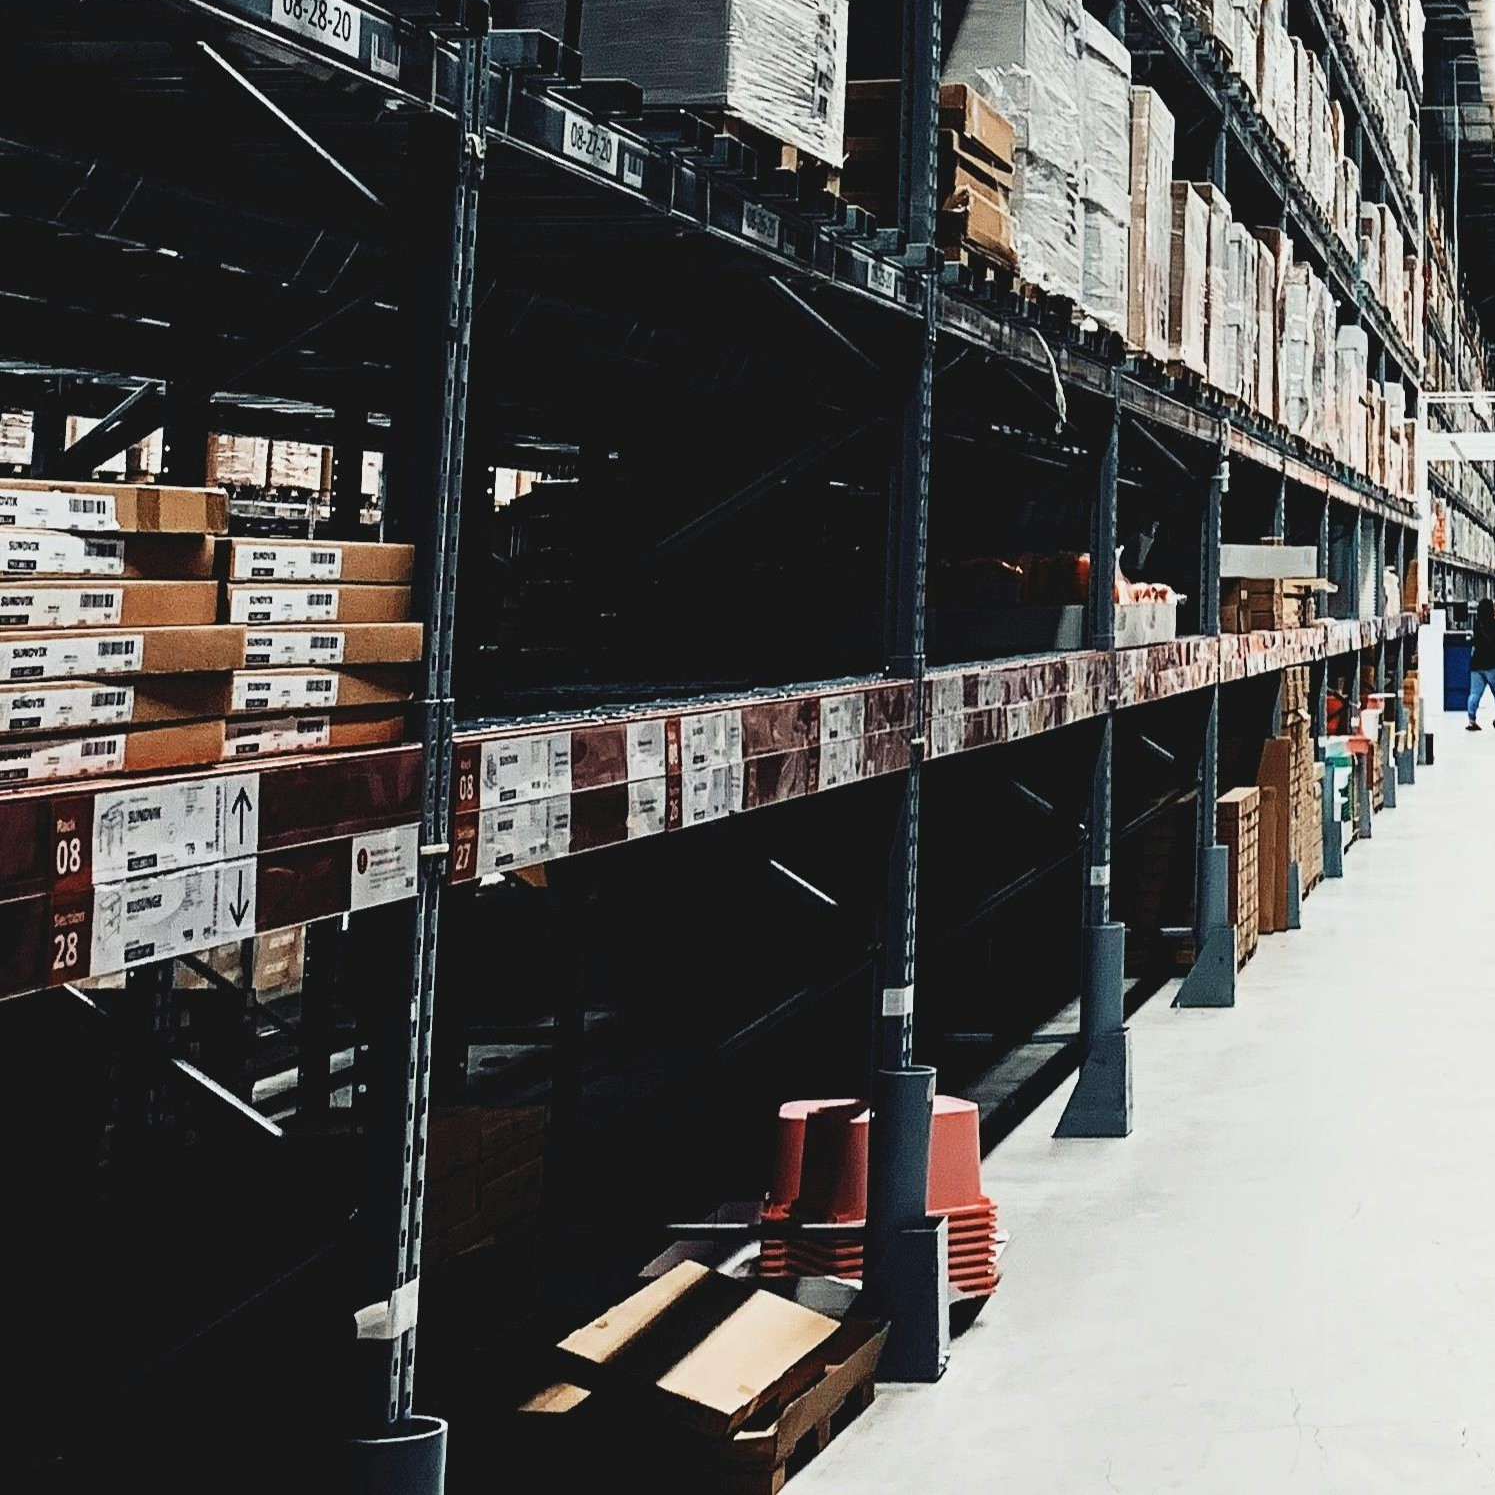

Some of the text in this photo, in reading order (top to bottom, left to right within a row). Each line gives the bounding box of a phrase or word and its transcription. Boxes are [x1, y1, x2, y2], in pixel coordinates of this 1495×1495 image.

[570, 121, 613, 164] 08-27-20
[459, 773, 474, 801] 08
[56, 819, 76, 834] Rack
[56, 837, 81, 875] 08
[455, 843, 472, 870] 27
[54, 910, 85, 928] Section
[52, 931, 78, 970] 28
